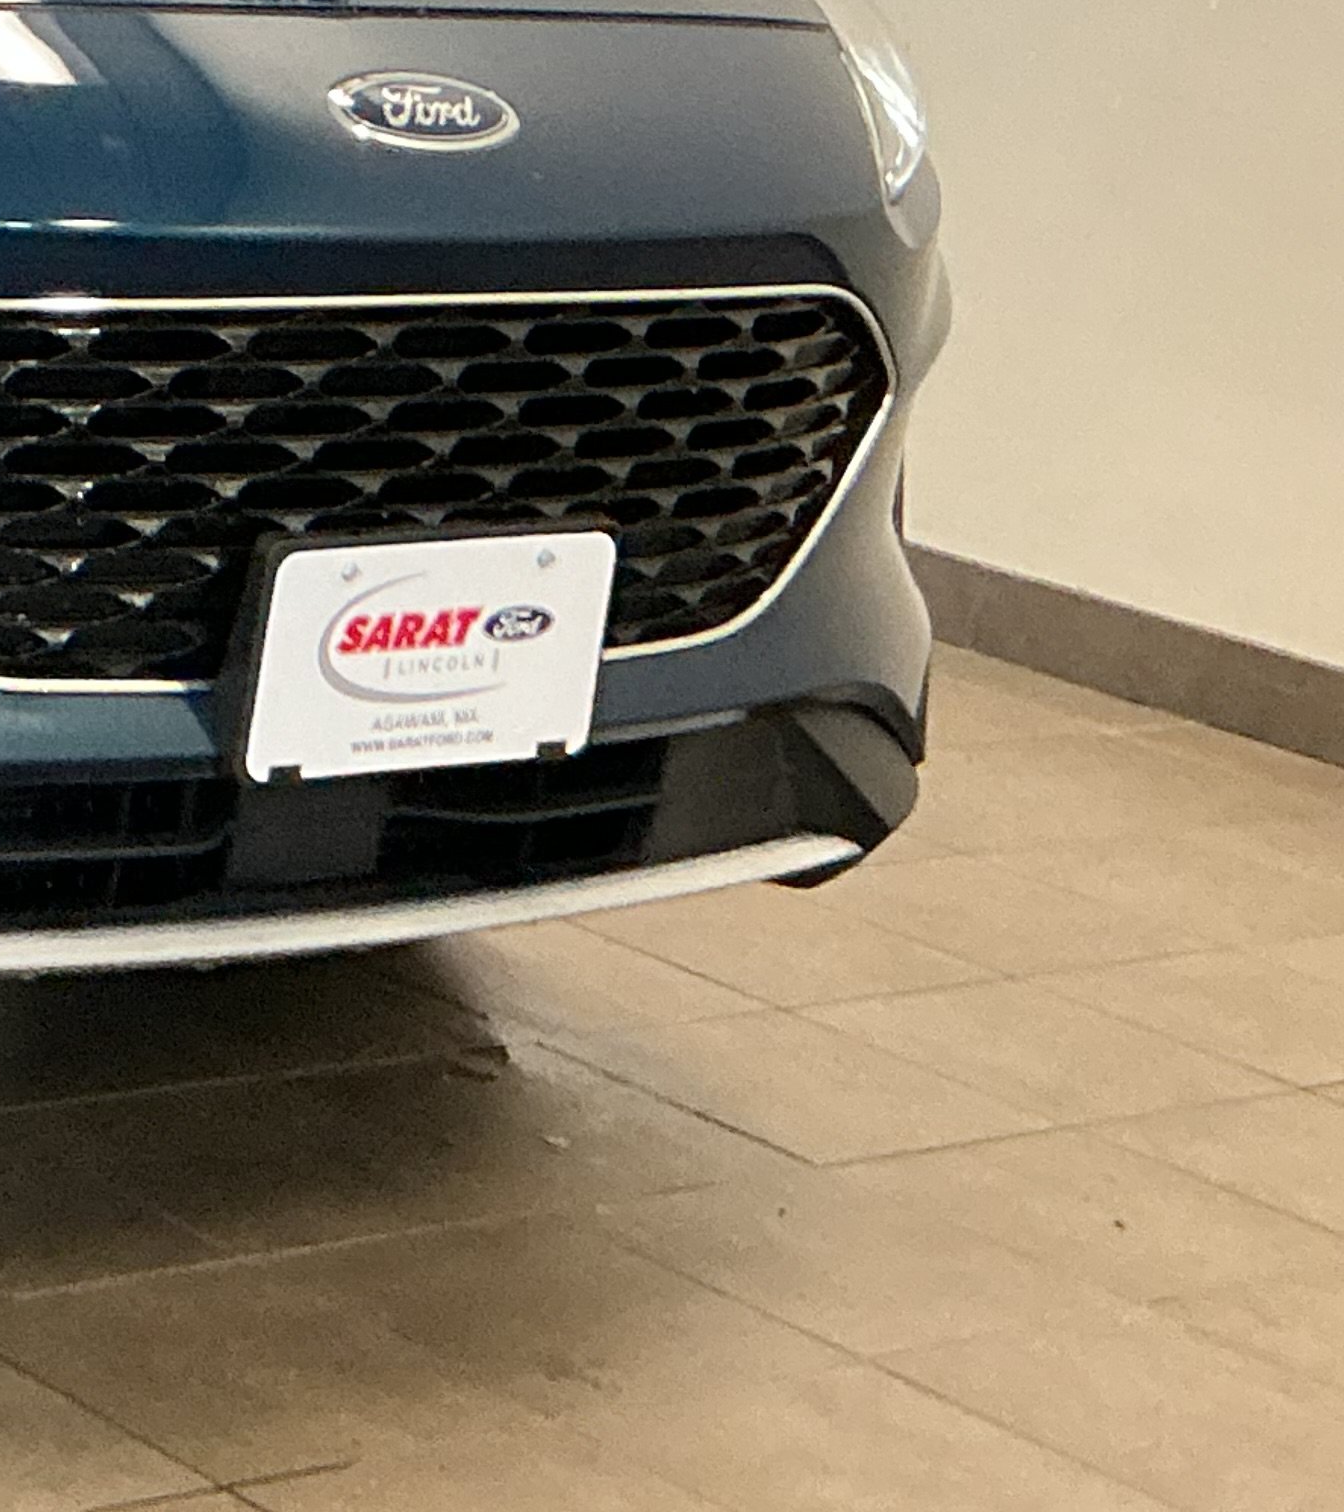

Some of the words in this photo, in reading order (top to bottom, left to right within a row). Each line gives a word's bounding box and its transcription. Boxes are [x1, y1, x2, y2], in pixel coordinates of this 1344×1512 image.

[381, 86, 481, 127] Ford
[338, 607, 481, 654] SARAT
[397, 654, 485, 676] LINCOLN
